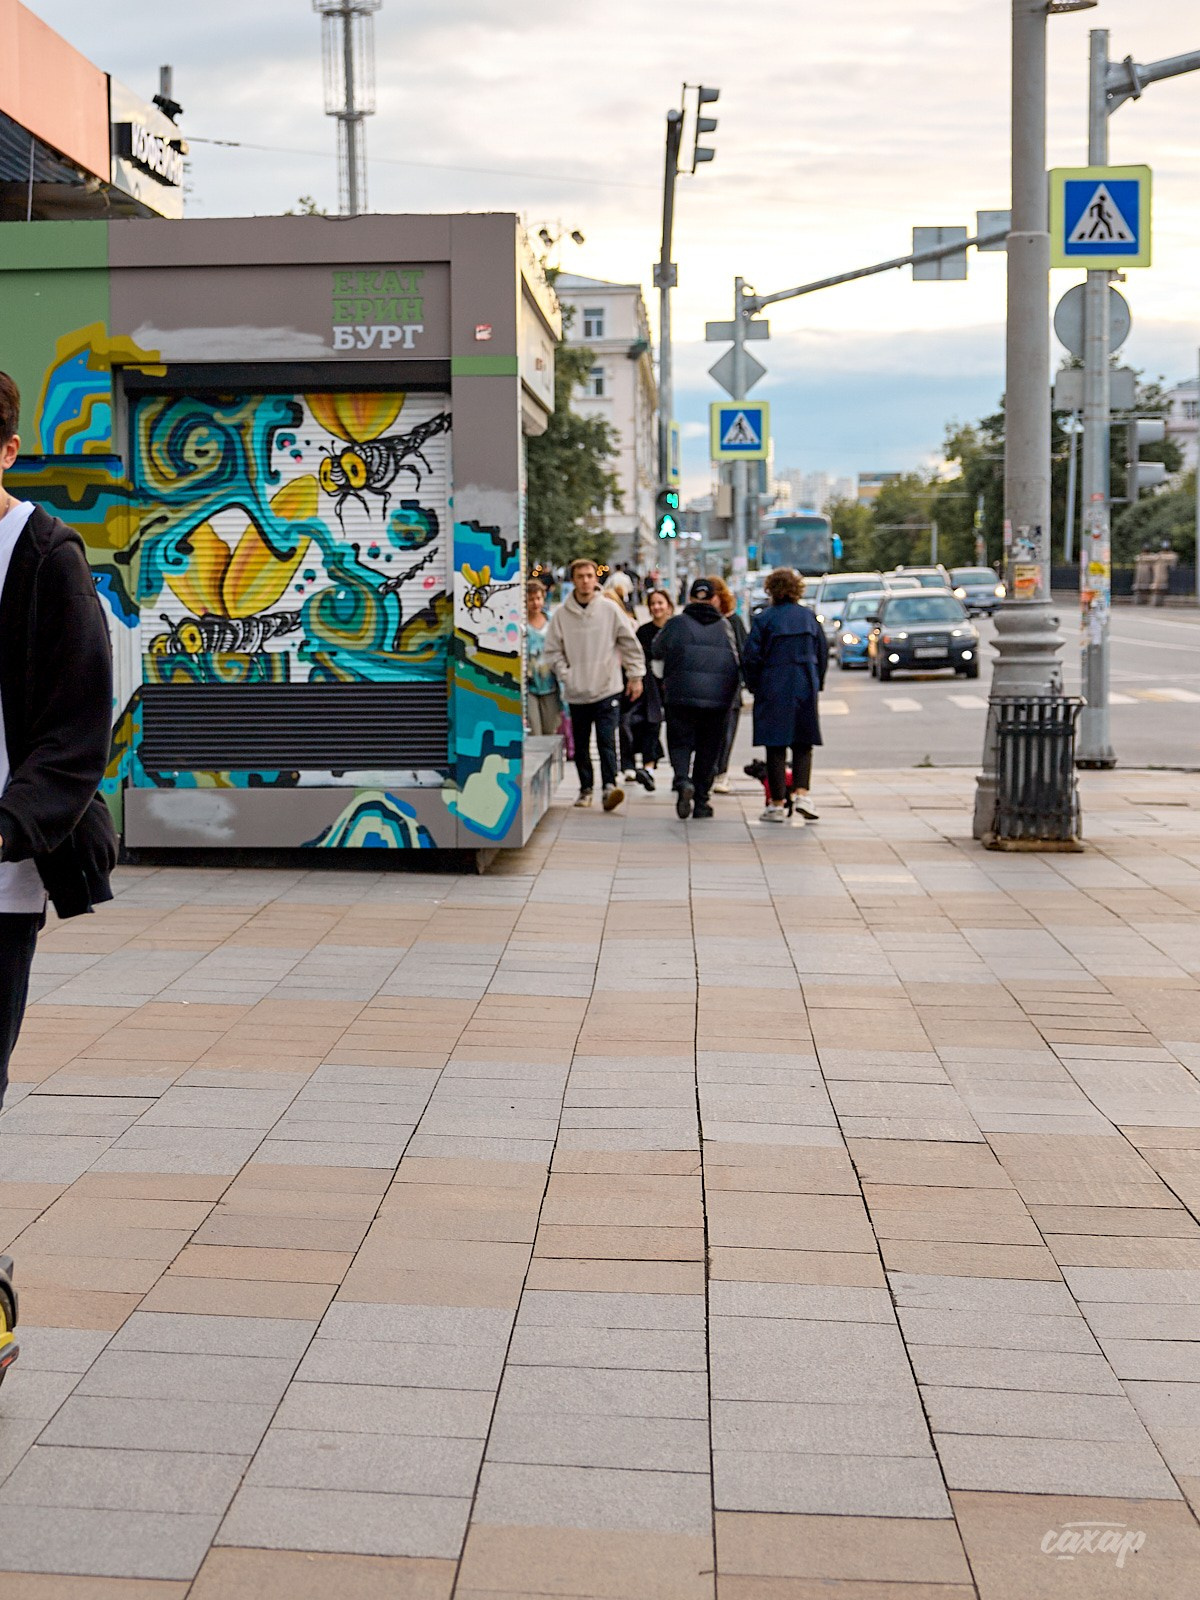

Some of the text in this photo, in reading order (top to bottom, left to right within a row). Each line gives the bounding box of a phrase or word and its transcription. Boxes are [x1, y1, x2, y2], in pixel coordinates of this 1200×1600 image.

[332, 270, 425, 295] ЕКАТ
[332, 298, 425, 322] ЕРИН
[332, 325, 425, 350] БУРГ
